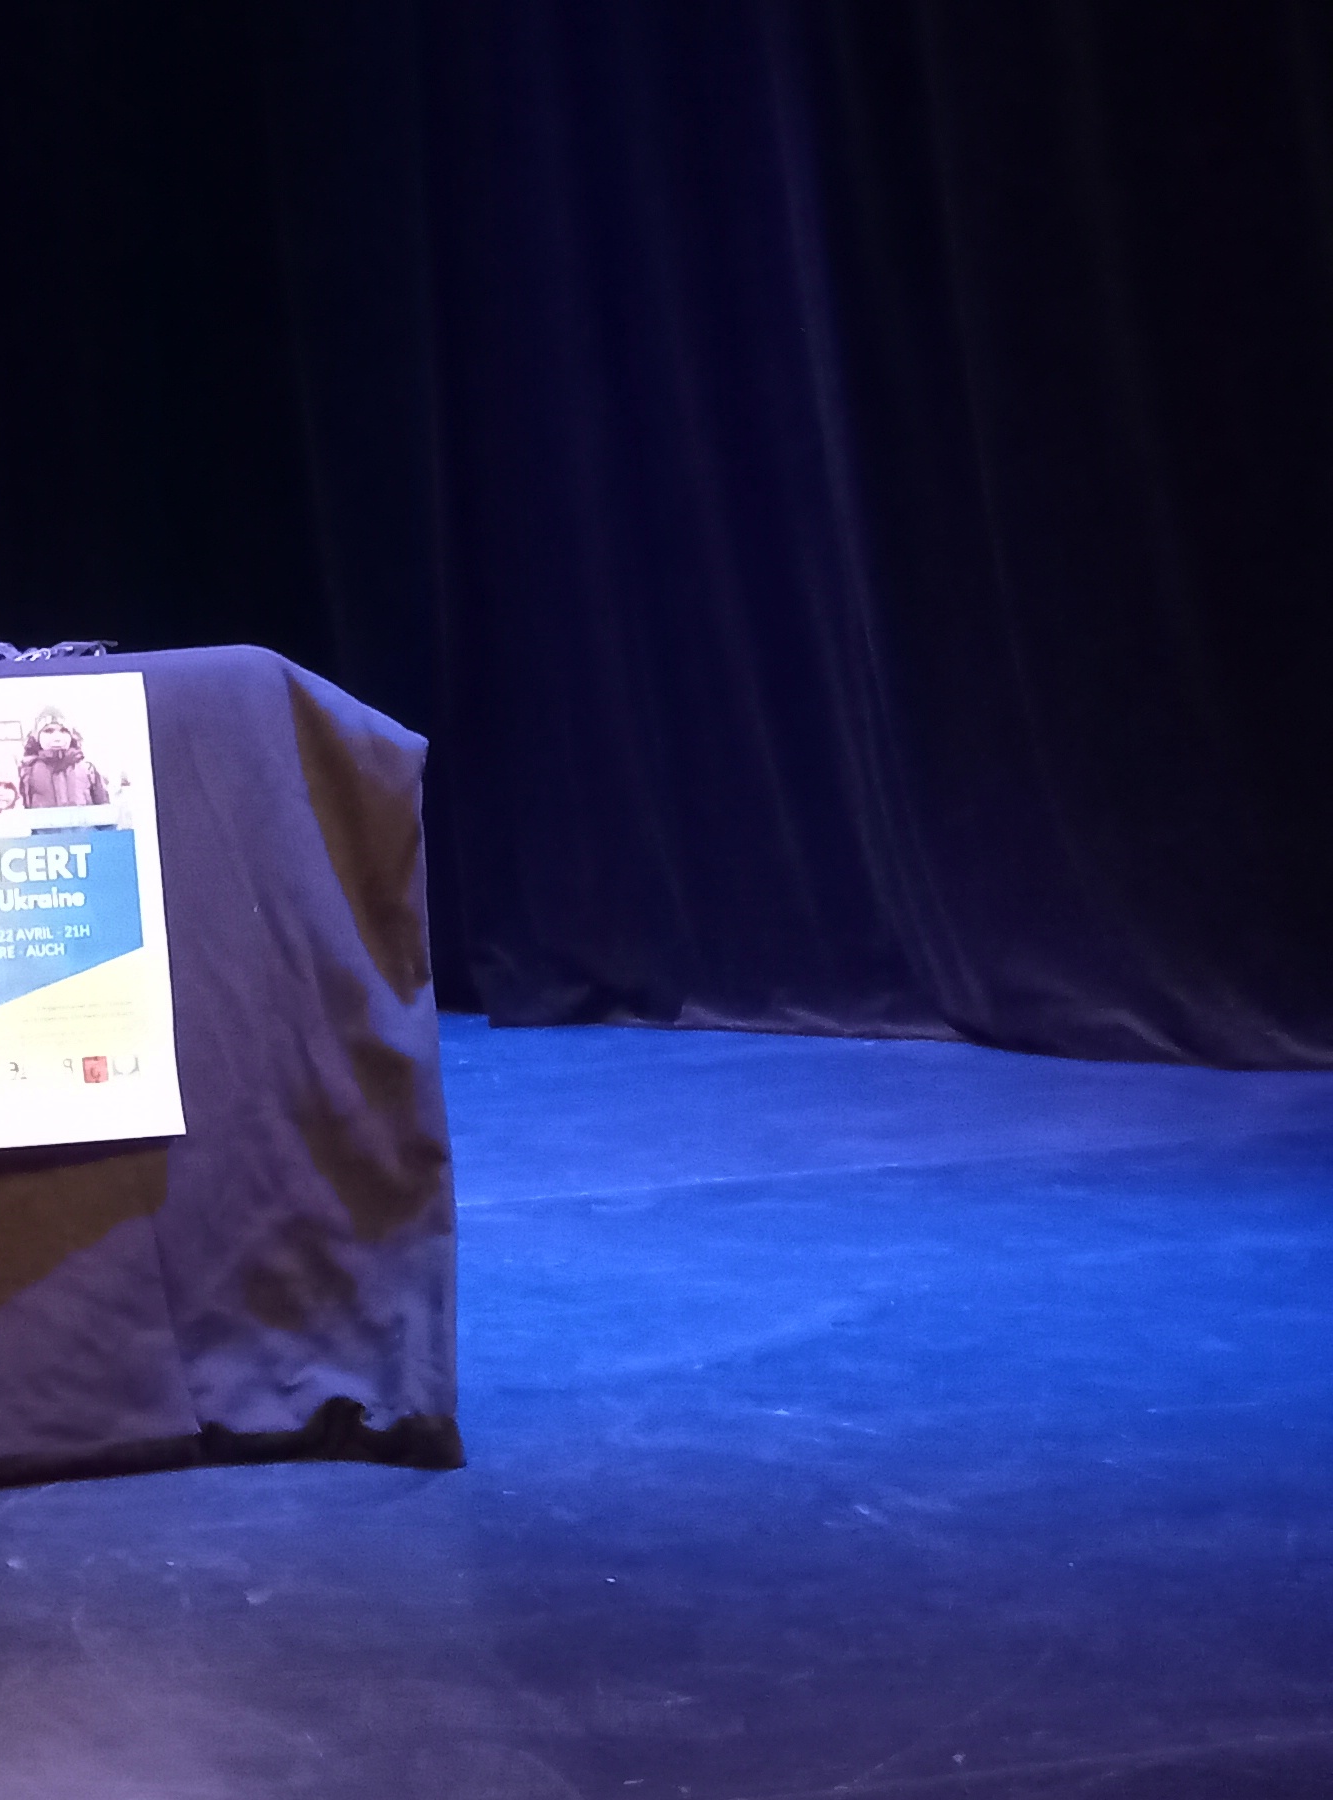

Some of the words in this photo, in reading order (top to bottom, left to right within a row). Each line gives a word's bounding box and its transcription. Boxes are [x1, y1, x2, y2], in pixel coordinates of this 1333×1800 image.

[15, 926, 53, 941] AVRIL
[63, 924, 91, 939] 21H
[26, 942, 66, 958] AUCH
